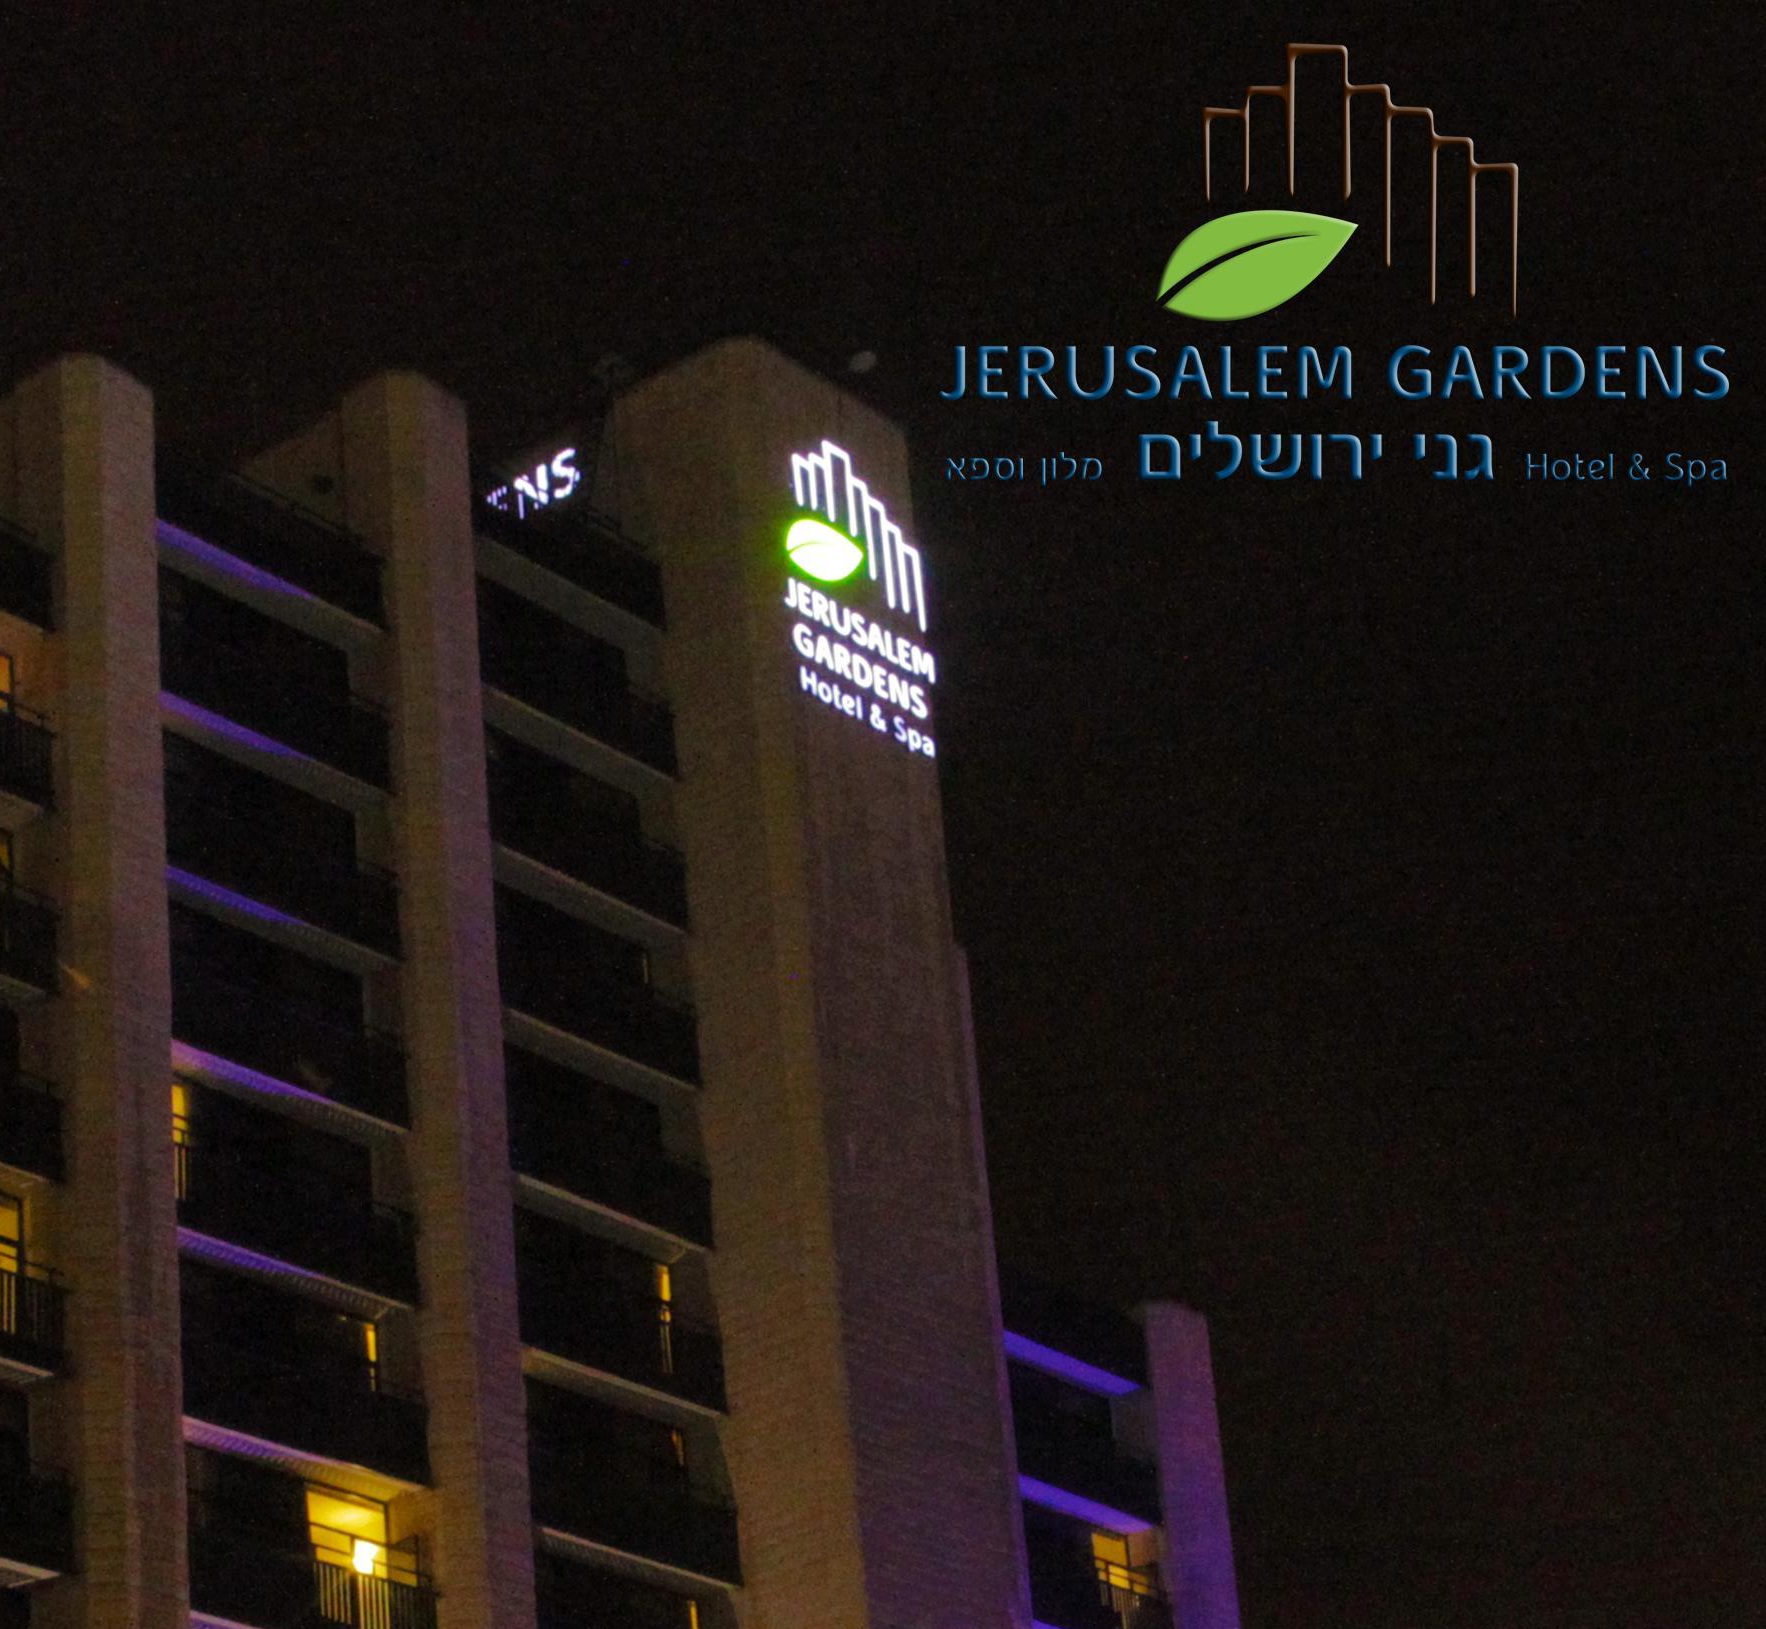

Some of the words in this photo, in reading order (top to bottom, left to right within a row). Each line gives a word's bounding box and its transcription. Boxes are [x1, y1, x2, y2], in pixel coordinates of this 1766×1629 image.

[784, 577, 936, 684] JERUSALEM
[793, 622, 929, 720] GARDENS
[799, 665, 864, 721] Hotel
[869, 702, 888, 733] &
[892, 714, 936, 758] Spa
